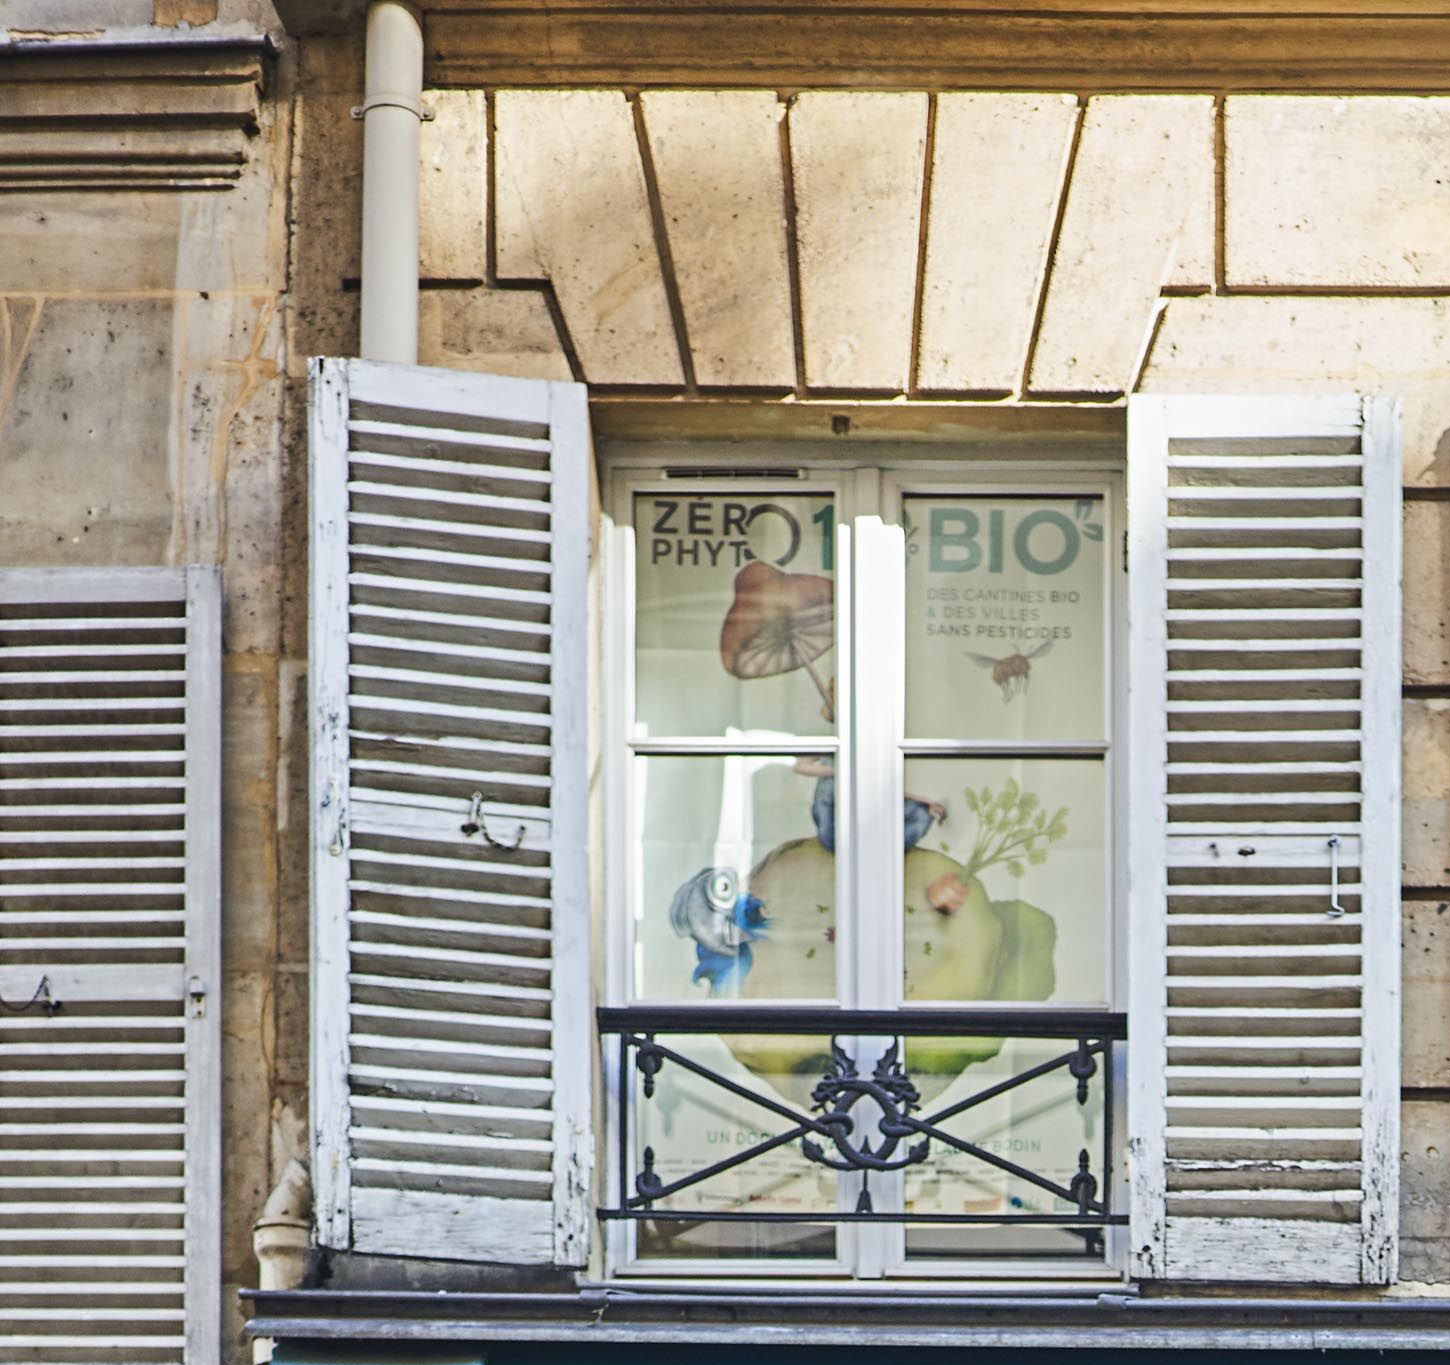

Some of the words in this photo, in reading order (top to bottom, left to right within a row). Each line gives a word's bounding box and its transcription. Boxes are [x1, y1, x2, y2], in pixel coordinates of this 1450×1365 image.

[929, 507, 1080, 575] BIO
[927, 587, 958, 602] DES
[964, 588, 1045, 602] CANTINES
[1050, 589, 1080, 603] BIO
[943, 606, 976, 620] DES
[982, 607, 1040, 621] VILLES
[926, 623, 969, 638] SANS
[976, 625, 1072, 639] PESTICIDES
[706, 1130, 730, 1145] UN
